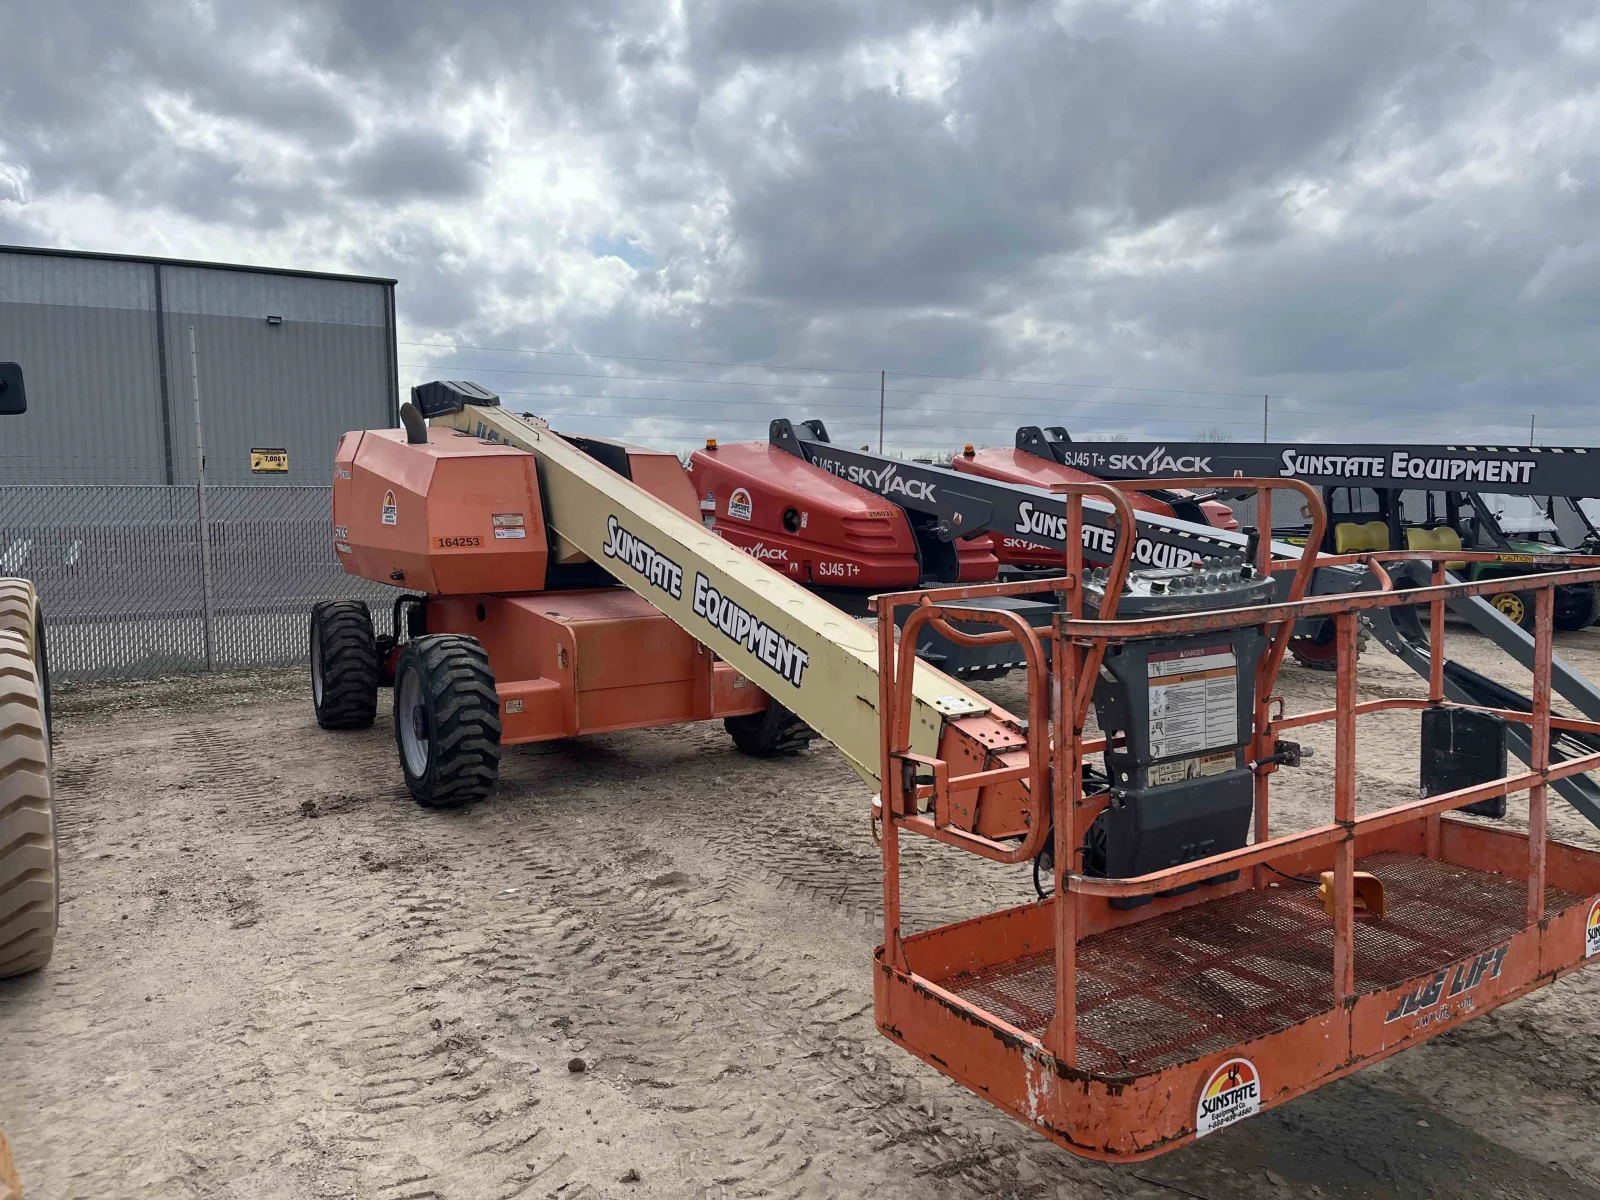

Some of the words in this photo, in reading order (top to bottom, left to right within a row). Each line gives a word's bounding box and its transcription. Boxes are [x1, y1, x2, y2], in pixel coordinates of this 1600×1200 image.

[1065, 451, 1090, 467] SJ45
[1092, 452, 1106, 467] T+
[1109, 446, 1214, 475] SKYJACK
[847, 463, 937, 503] SKYJACK
[438, 537, 480, 548] 164253
[819, 562, 845, 576] SJ45
[847, 563, 861, 577] T+
[1183, 648, 1205, 657] DANGER
[1209, 752, 1233, 762] WARNING
